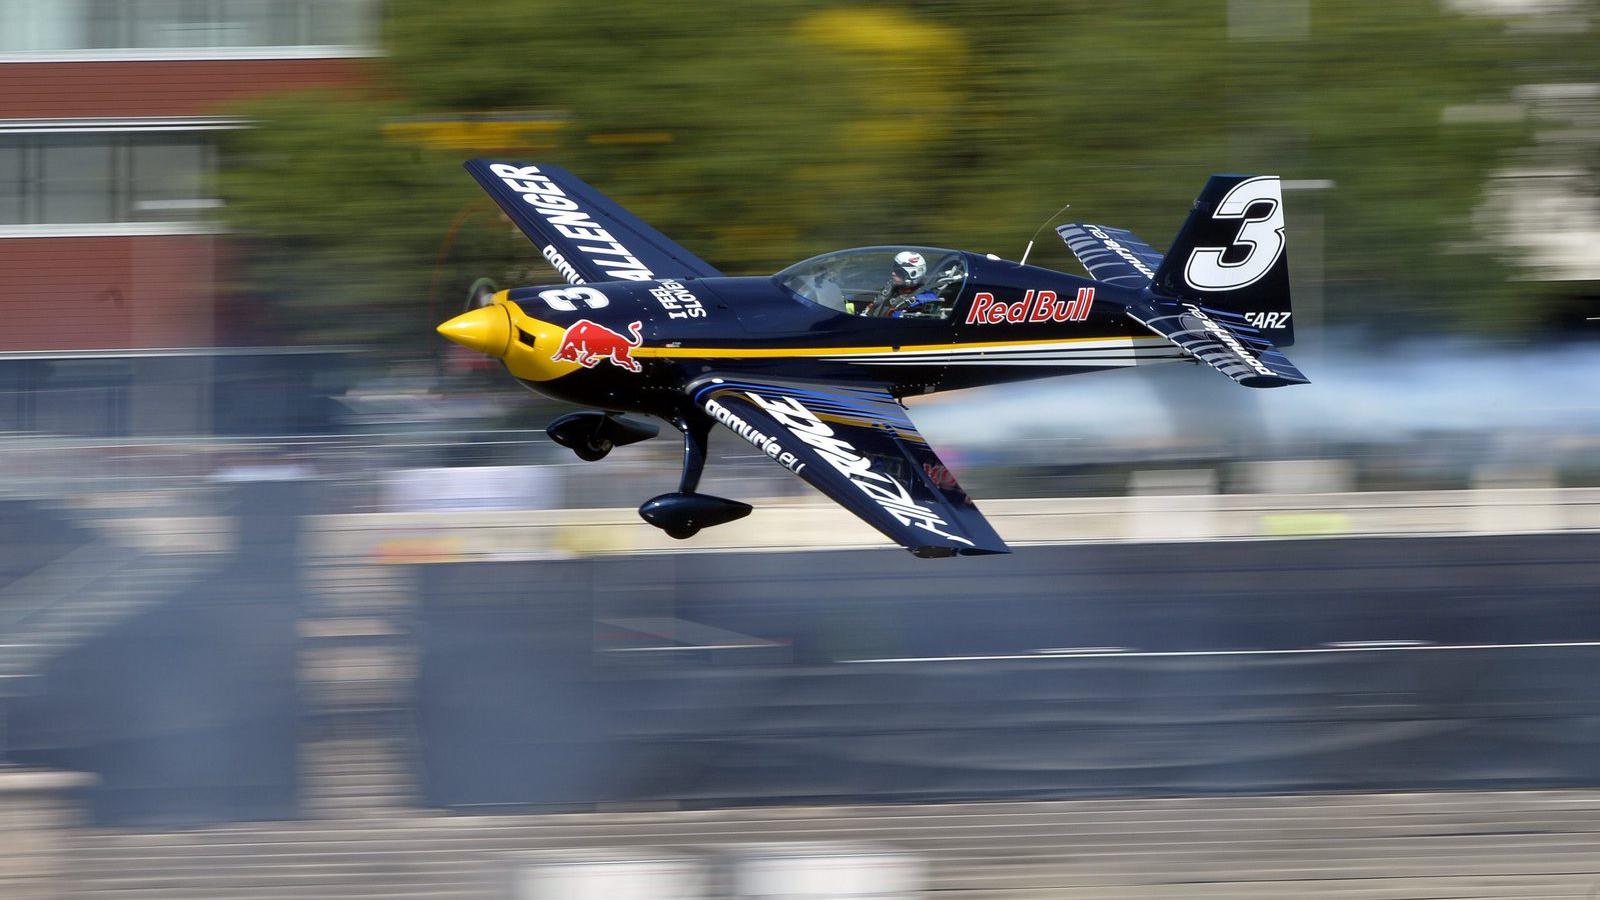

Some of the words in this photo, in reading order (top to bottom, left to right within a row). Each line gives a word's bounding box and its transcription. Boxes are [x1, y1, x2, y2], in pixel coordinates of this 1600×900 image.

[489, 163, 656, 282] ALLENGER
[1184, 174, 1287, 292] 3
[538, 286, 610, 313] 3
[648, 285, 683, 310] FEEL
[965, 289, 1035, 325] Red
[1028, 287, 1095, 323] Bull
